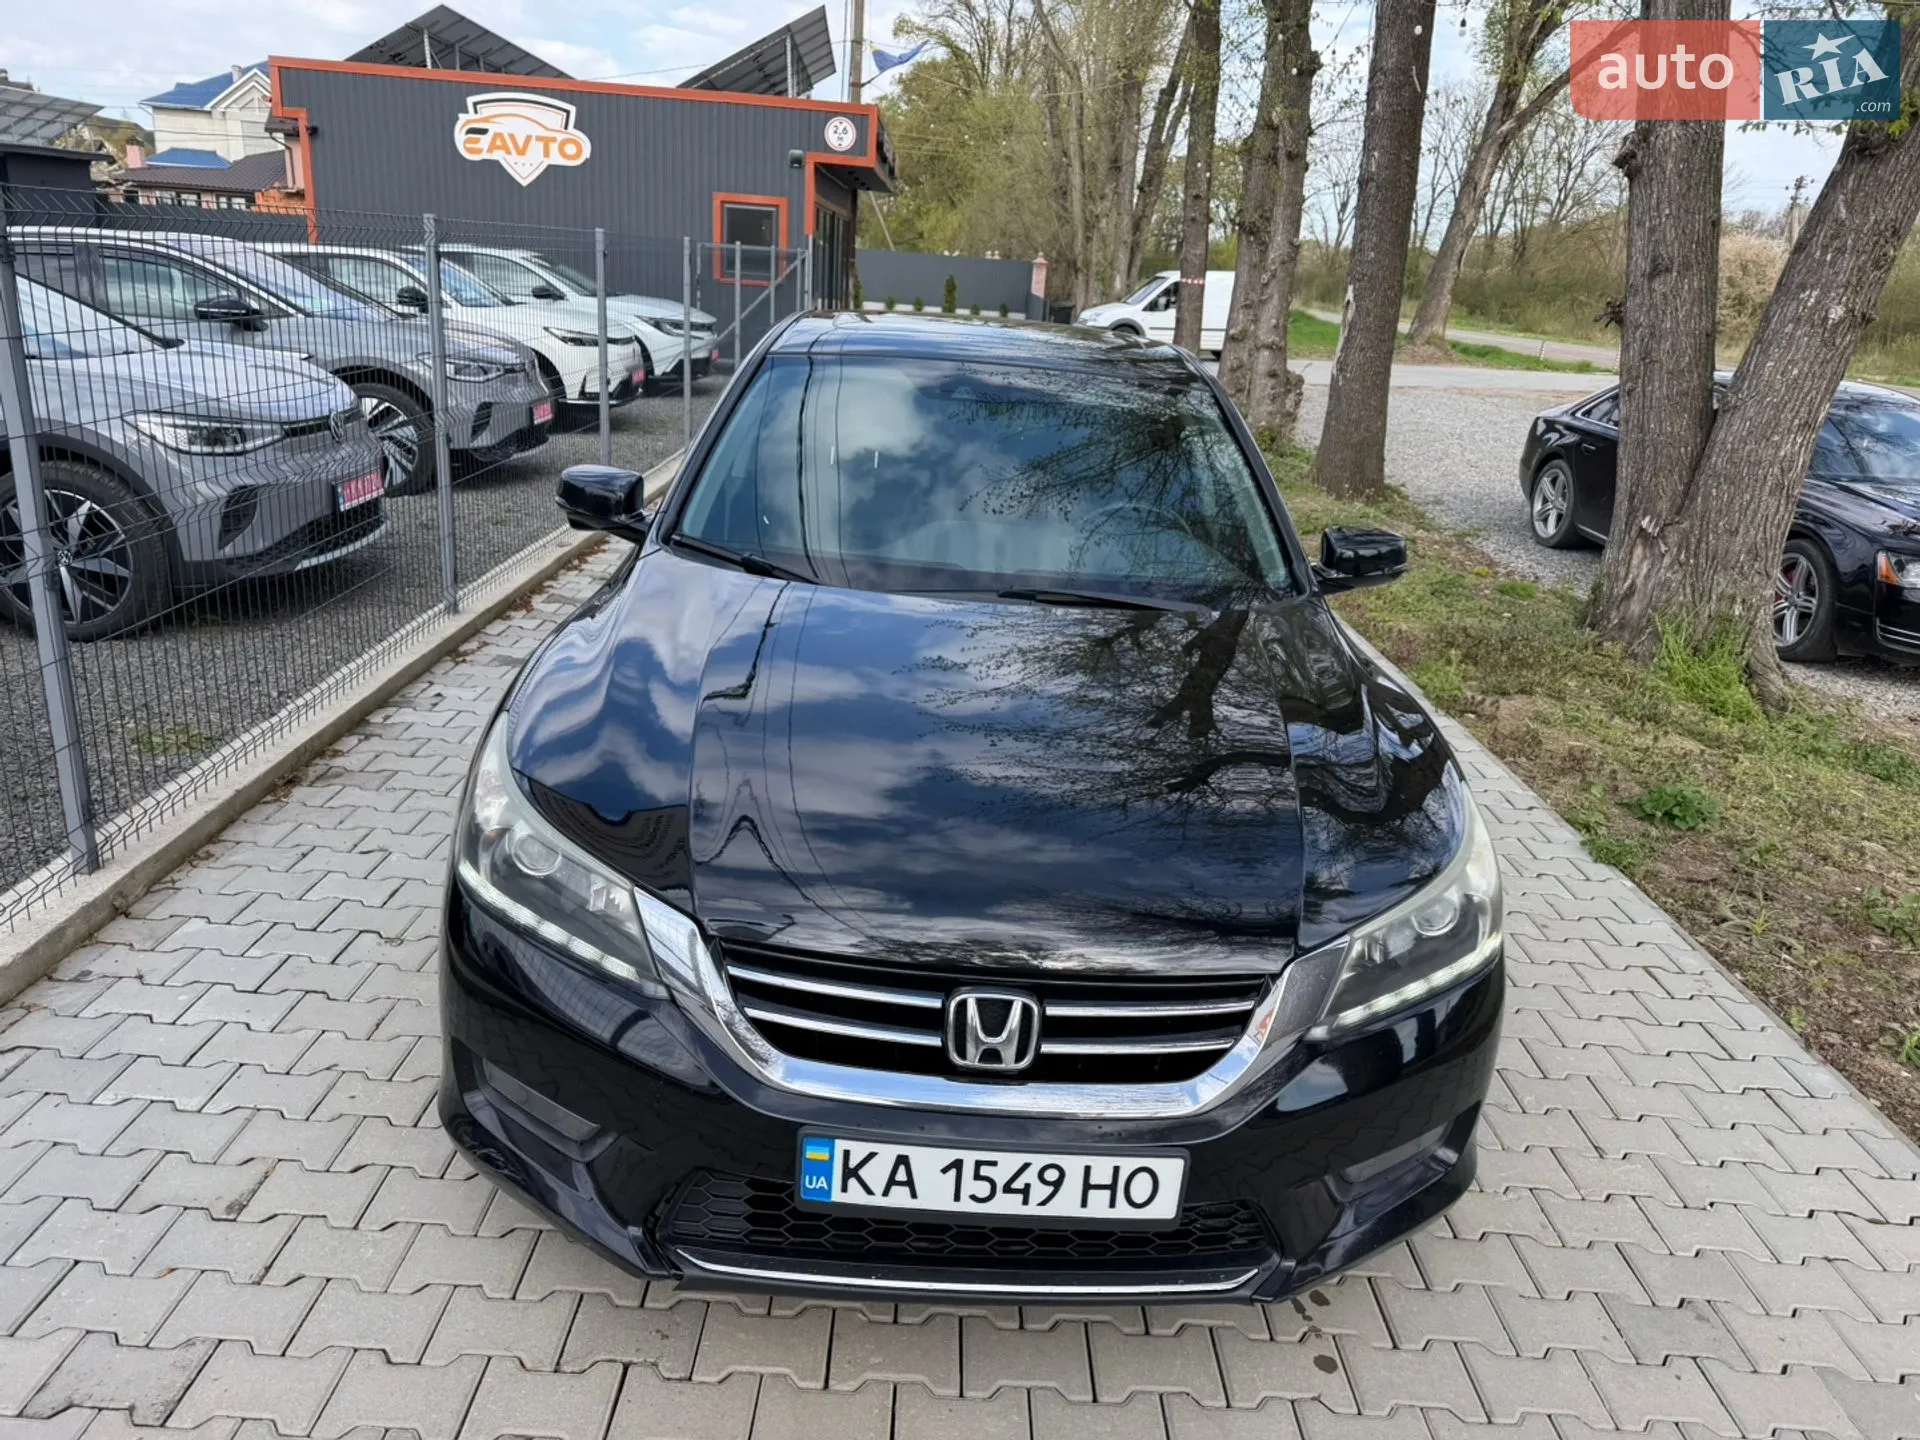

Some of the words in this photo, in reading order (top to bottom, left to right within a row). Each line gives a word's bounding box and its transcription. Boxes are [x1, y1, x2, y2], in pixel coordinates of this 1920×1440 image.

[805, 1175, 828, 1190] UA
[840, 1149, 918, 1200] KA
[940, 1157, 1066, 1207] 1549
